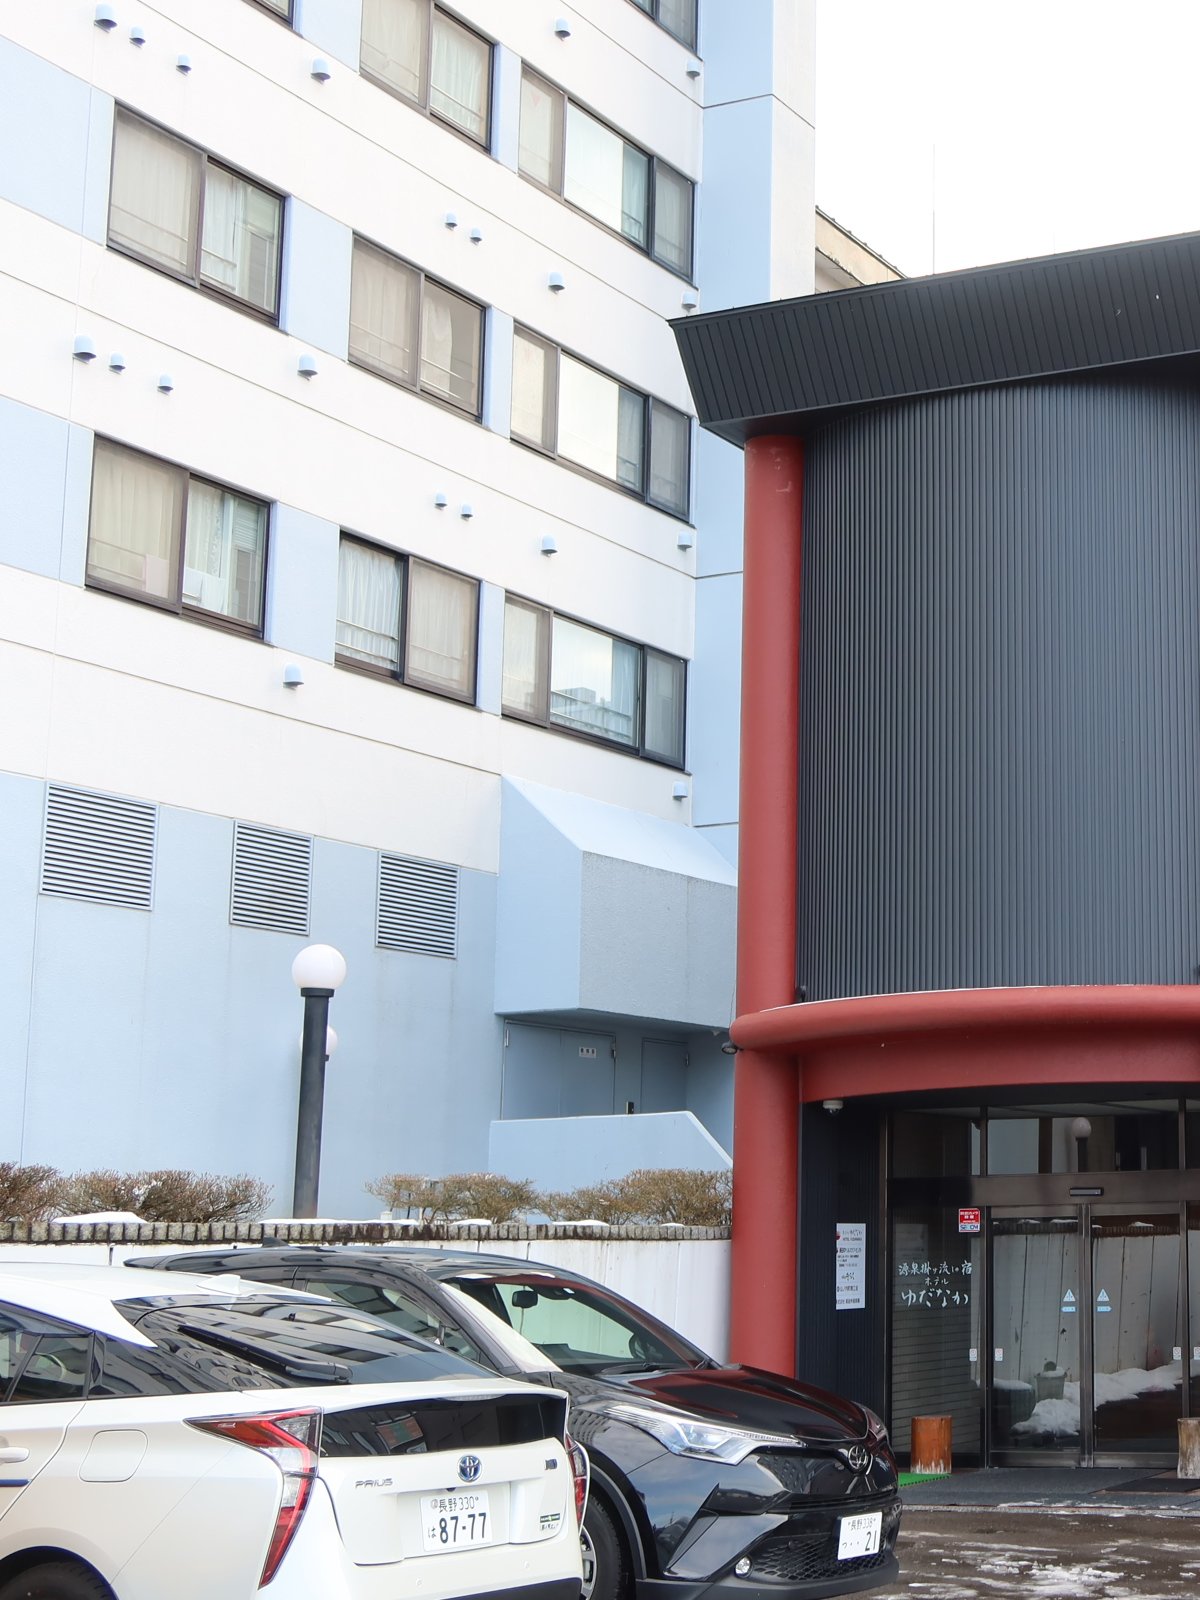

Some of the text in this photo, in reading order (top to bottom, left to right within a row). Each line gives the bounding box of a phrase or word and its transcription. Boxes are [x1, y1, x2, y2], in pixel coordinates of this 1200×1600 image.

[924, 1276, 949, 1286] ホテル
[901, 1288, 969, 1308] ゆだなか
[355, 1477, 393, 1489] PRIUS
